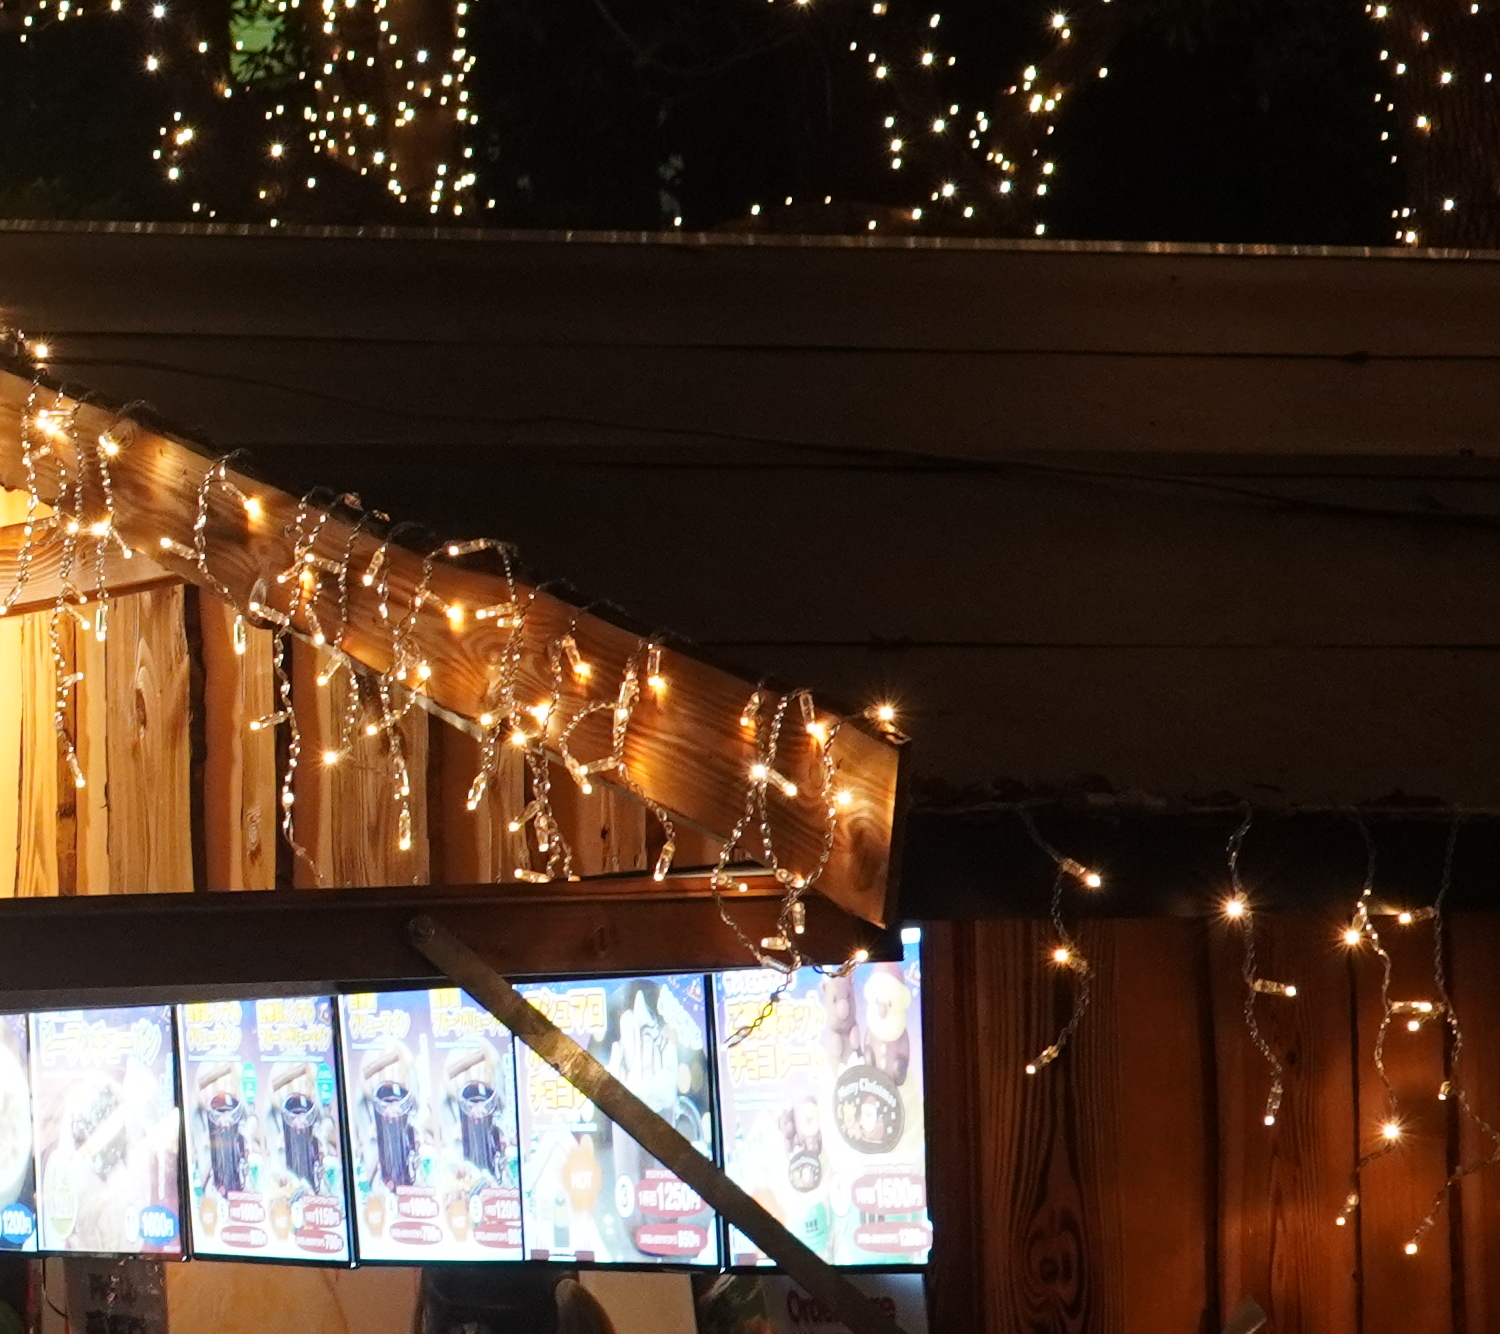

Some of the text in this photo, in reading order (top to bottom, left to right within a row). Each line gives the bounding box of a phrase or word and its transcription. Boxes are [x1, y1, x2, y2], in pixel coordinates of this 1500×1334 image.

[530, 1072, 593, 1113] チョコレ
[570, 1172, 592, 1189] HOT
[657, 1182, 701, 1211] 1250円
[496, 1200, 520, 1219] 1200
[2, 1211, 32, 1235] 1200円
[141, 1212, 174, 1237] 1600円
